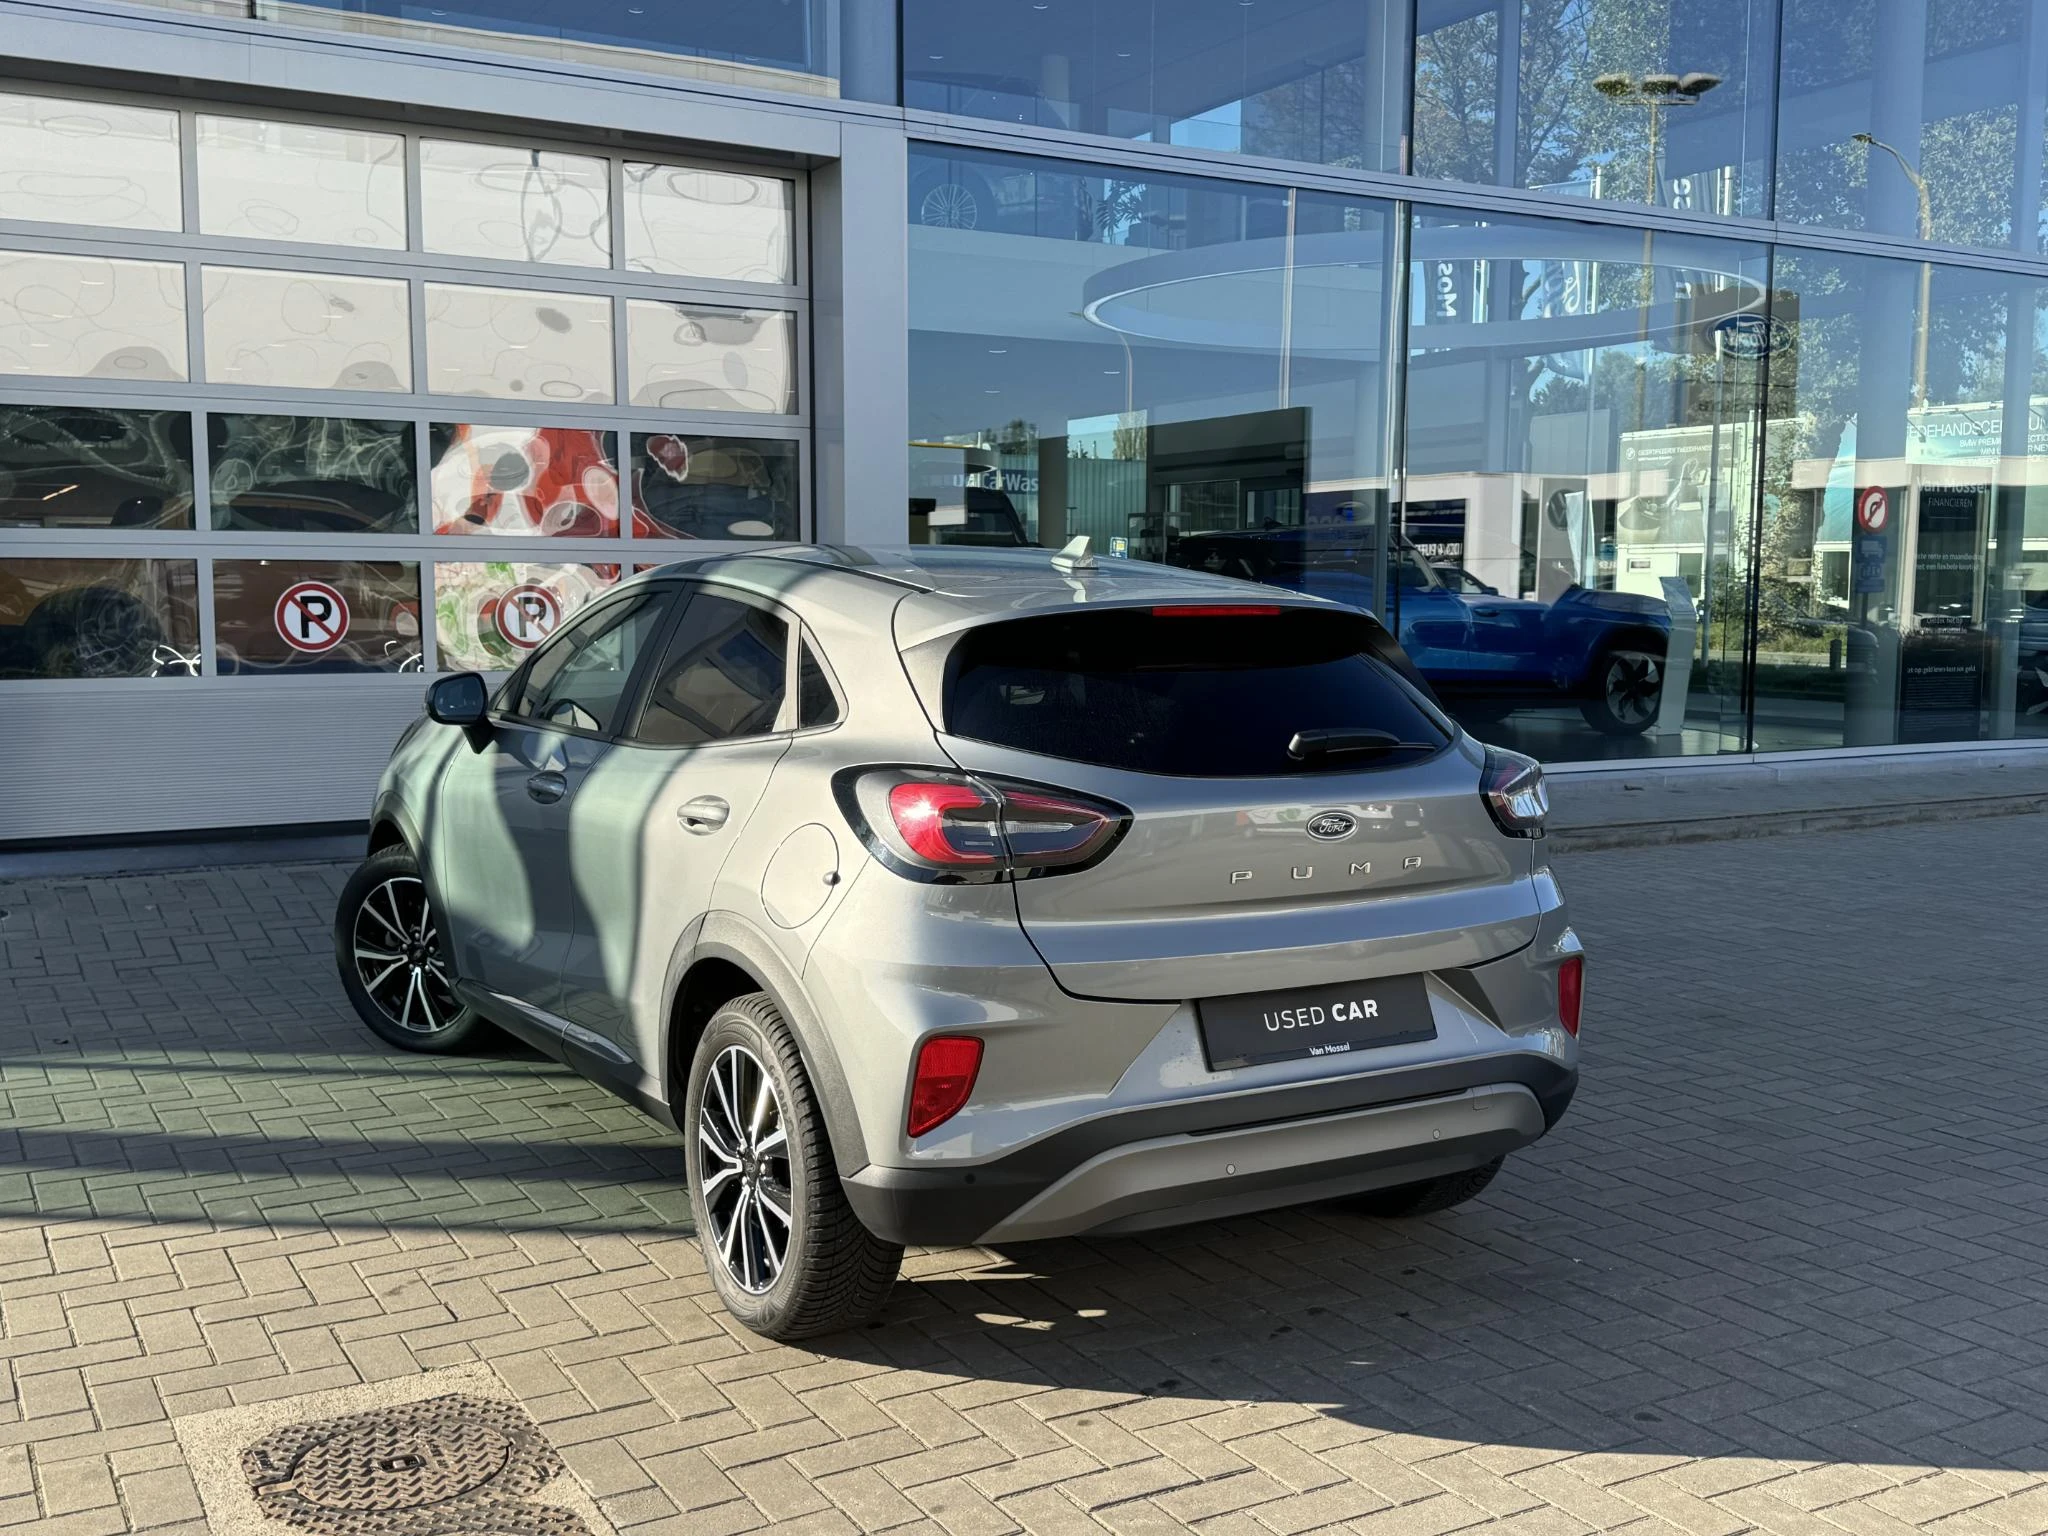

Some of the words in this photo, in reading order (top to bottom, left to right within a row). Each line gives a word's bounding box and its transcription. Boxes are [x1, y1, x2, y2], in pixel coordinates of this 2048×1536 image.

[1231, 855, 1422, 885] PUMA
[1264, 1005, 1325, 1032] USED
[1331, 999, 1379, 1022] CAR
[1309, 1044, 1324, 1056] Van
[1324, 1042, 1350, 1055] Mossel
